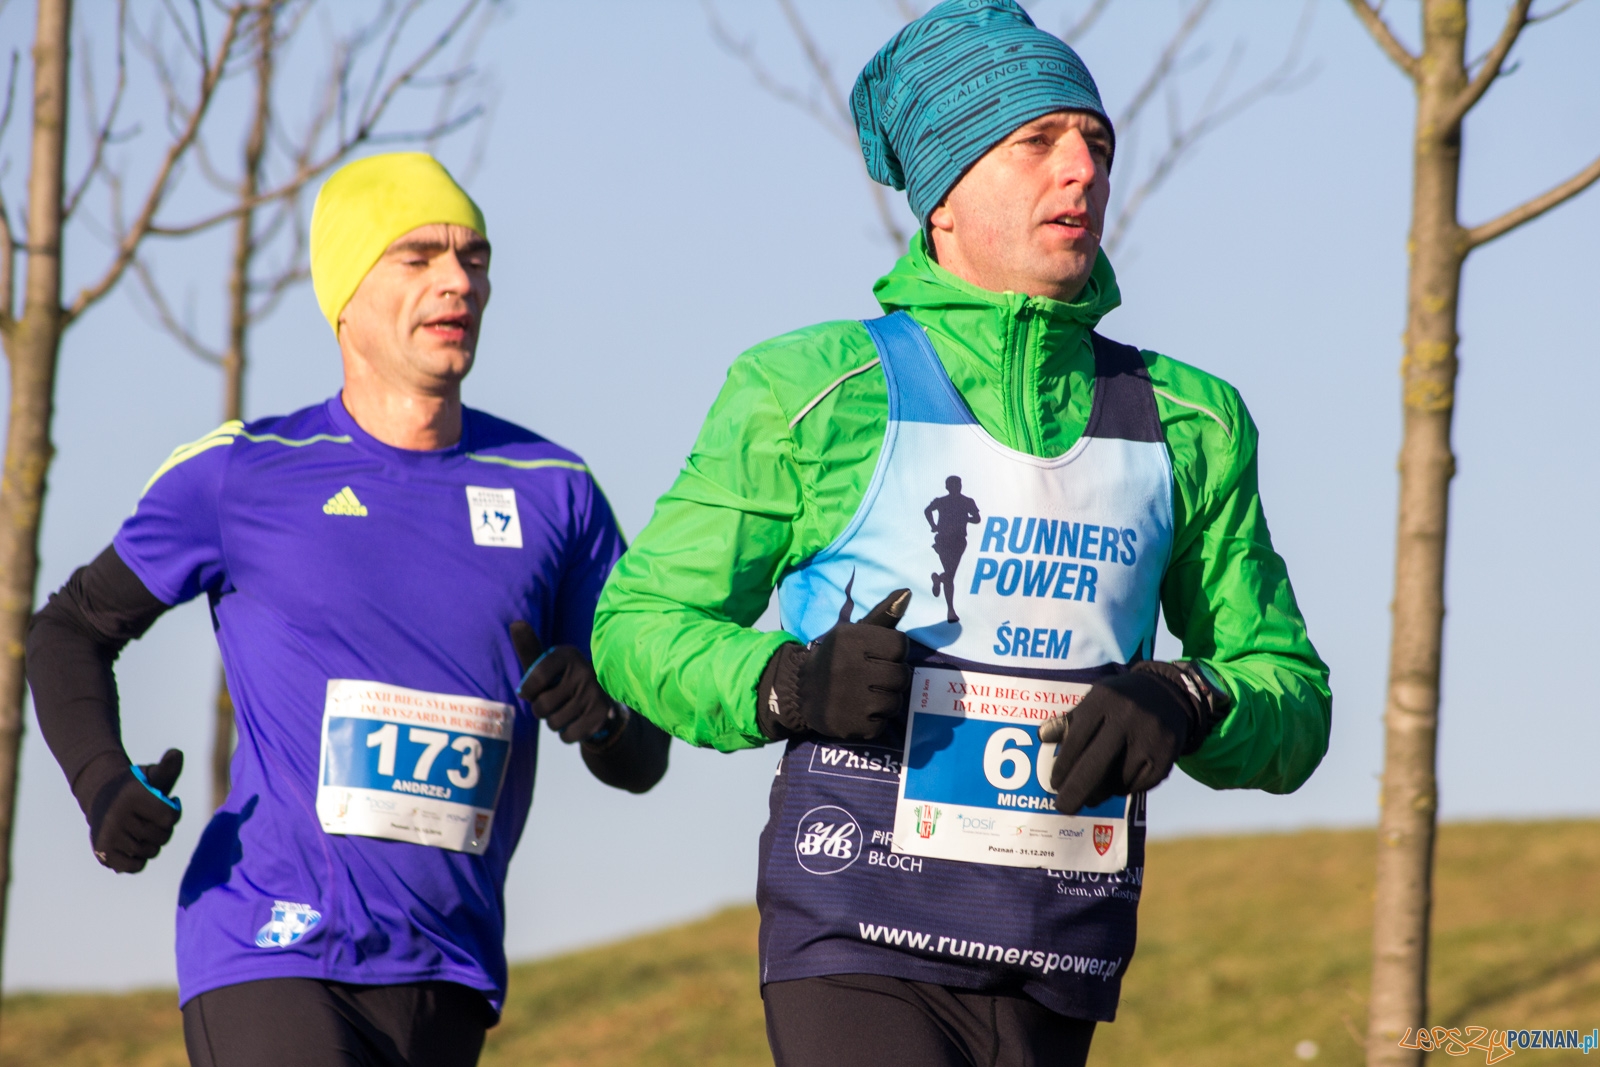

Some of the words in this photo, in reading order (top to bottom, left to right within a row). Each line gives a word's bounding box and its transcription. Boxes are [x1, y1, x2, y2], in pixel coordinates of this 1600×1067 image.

[936, 62, 1028, 115] CHALLENGE
[322, 503, 369, 517] adidas
[979, 515, 1138, 567] RUNNER'S
[969, 557, 1099, 604] POWER
[993, 620, 1073, 660] ŚREM
[923, 679, 930, 691] km
[947, 681, 990, 698] XXXII
[995, 687, 1031, 702] BIEG
[952, 699, 976, 713] IM.
[980, 702, 1058, 721] RYSZARDA
[366, 723, 483, 790] 173
[820, 746, 903, 779] Whisk
[391, 778, 453, 800] ANDRZEJ
[997, 791, 1057, 811] MICHAŁ
[962, 816, 996, 831] posir
[871, 829, 893, 847] FIR
[988, 845, 1014, 854] Poznań
[868, 850, 923, 873] BŁOCH
[1056, 880, 1092, 898] Śrem,
[1093, 886, 1109, 898] ul.
[858, 922, 1122, 982] www.runnerspower.pl
